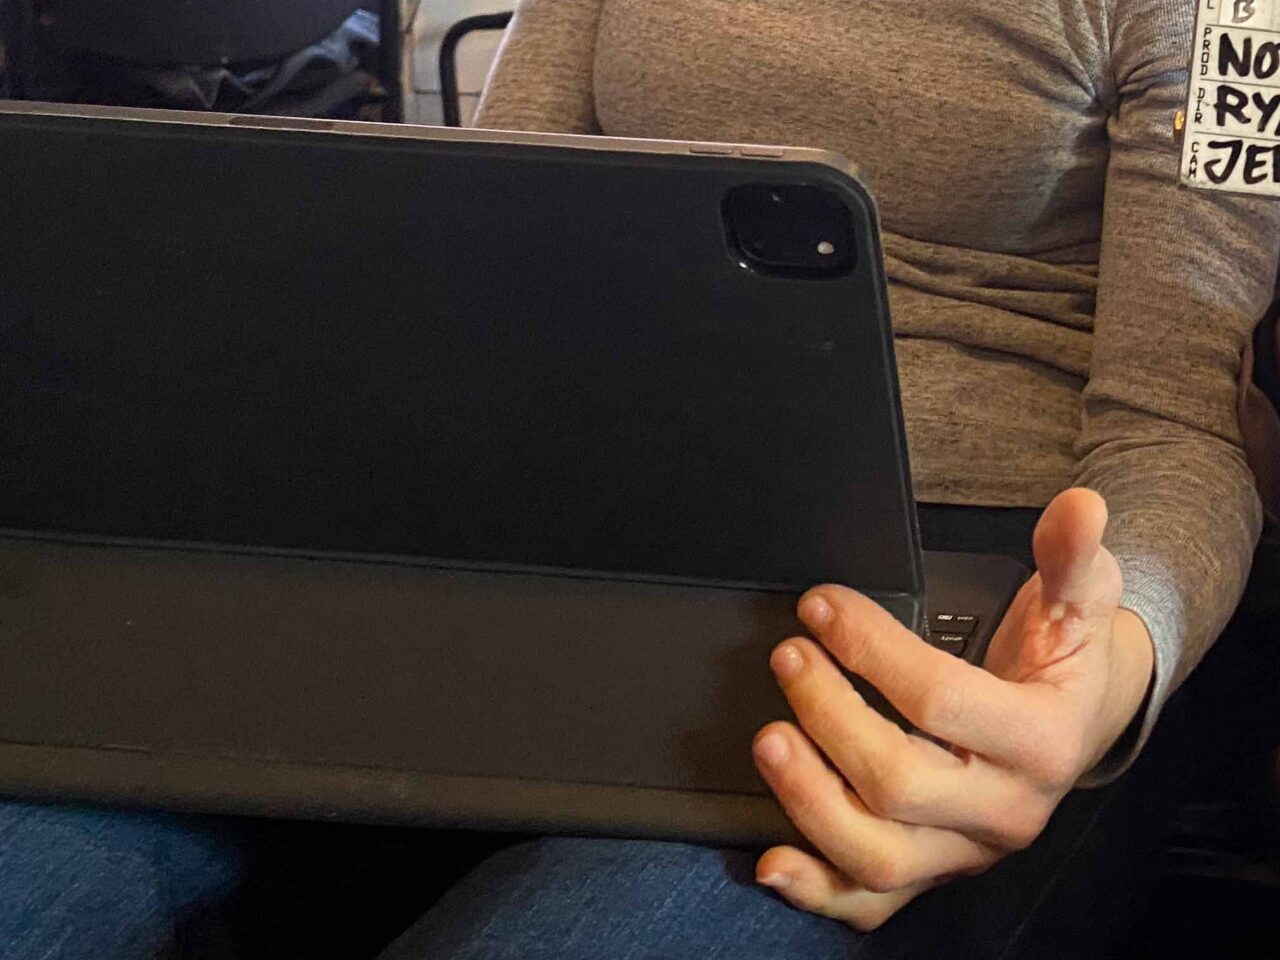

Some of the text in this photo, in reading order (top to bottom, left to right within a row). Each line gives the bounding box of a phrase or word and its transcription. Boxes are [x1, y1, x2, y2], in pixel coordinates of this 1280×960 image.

[1200, 27, 1212, 76] PROD
[1194, 87, 1205, 124] DIR
[1188, 141, 1200, 178] CAM
